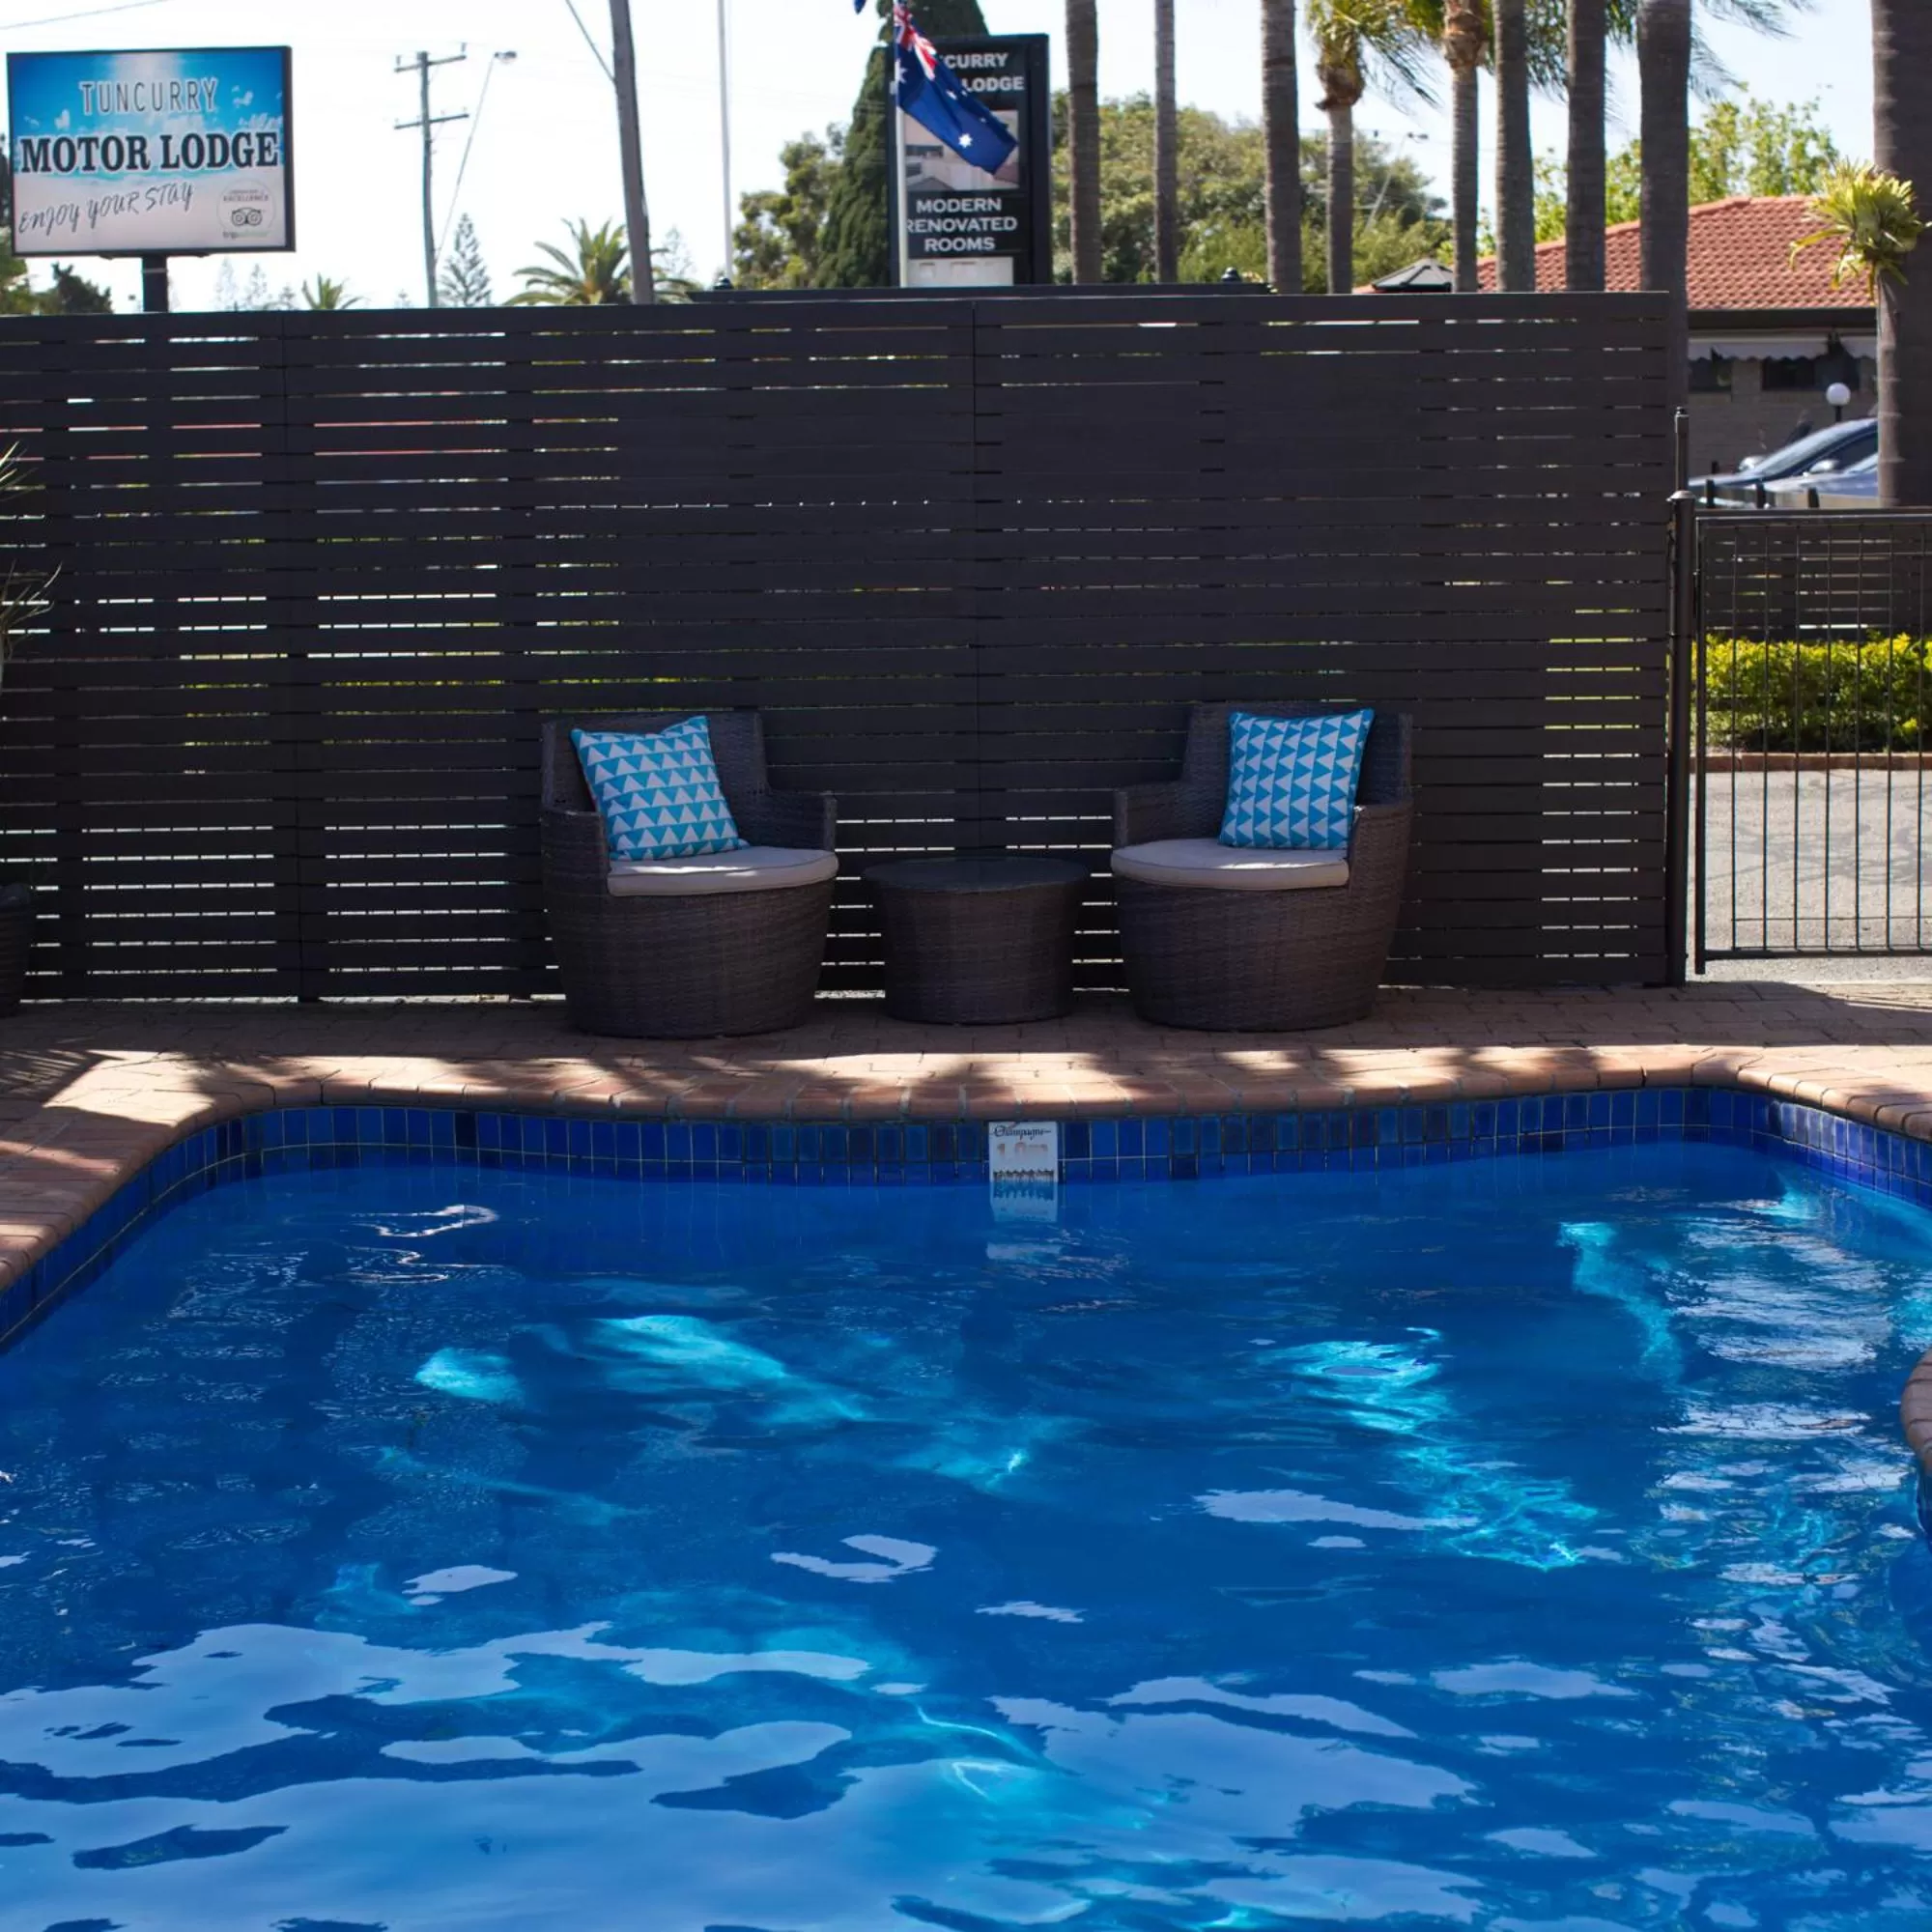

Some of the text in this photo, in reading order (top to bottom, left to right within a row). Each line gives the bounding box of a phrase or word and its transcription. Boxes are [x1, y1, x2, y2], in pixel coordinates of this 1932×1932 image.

[940, 52, 1009, 70] CURRY
[962, 76, 1026, 93] LODGE
[80, 79, 218, 114] TUNCURRY
[19, 131, 279, 174] MOTOR LODGE
[916, 196, 1003, 213] MODERN
[906, 215, 1018, 234] RENOVATED
[923, 237, 996, 253] ROOMS
